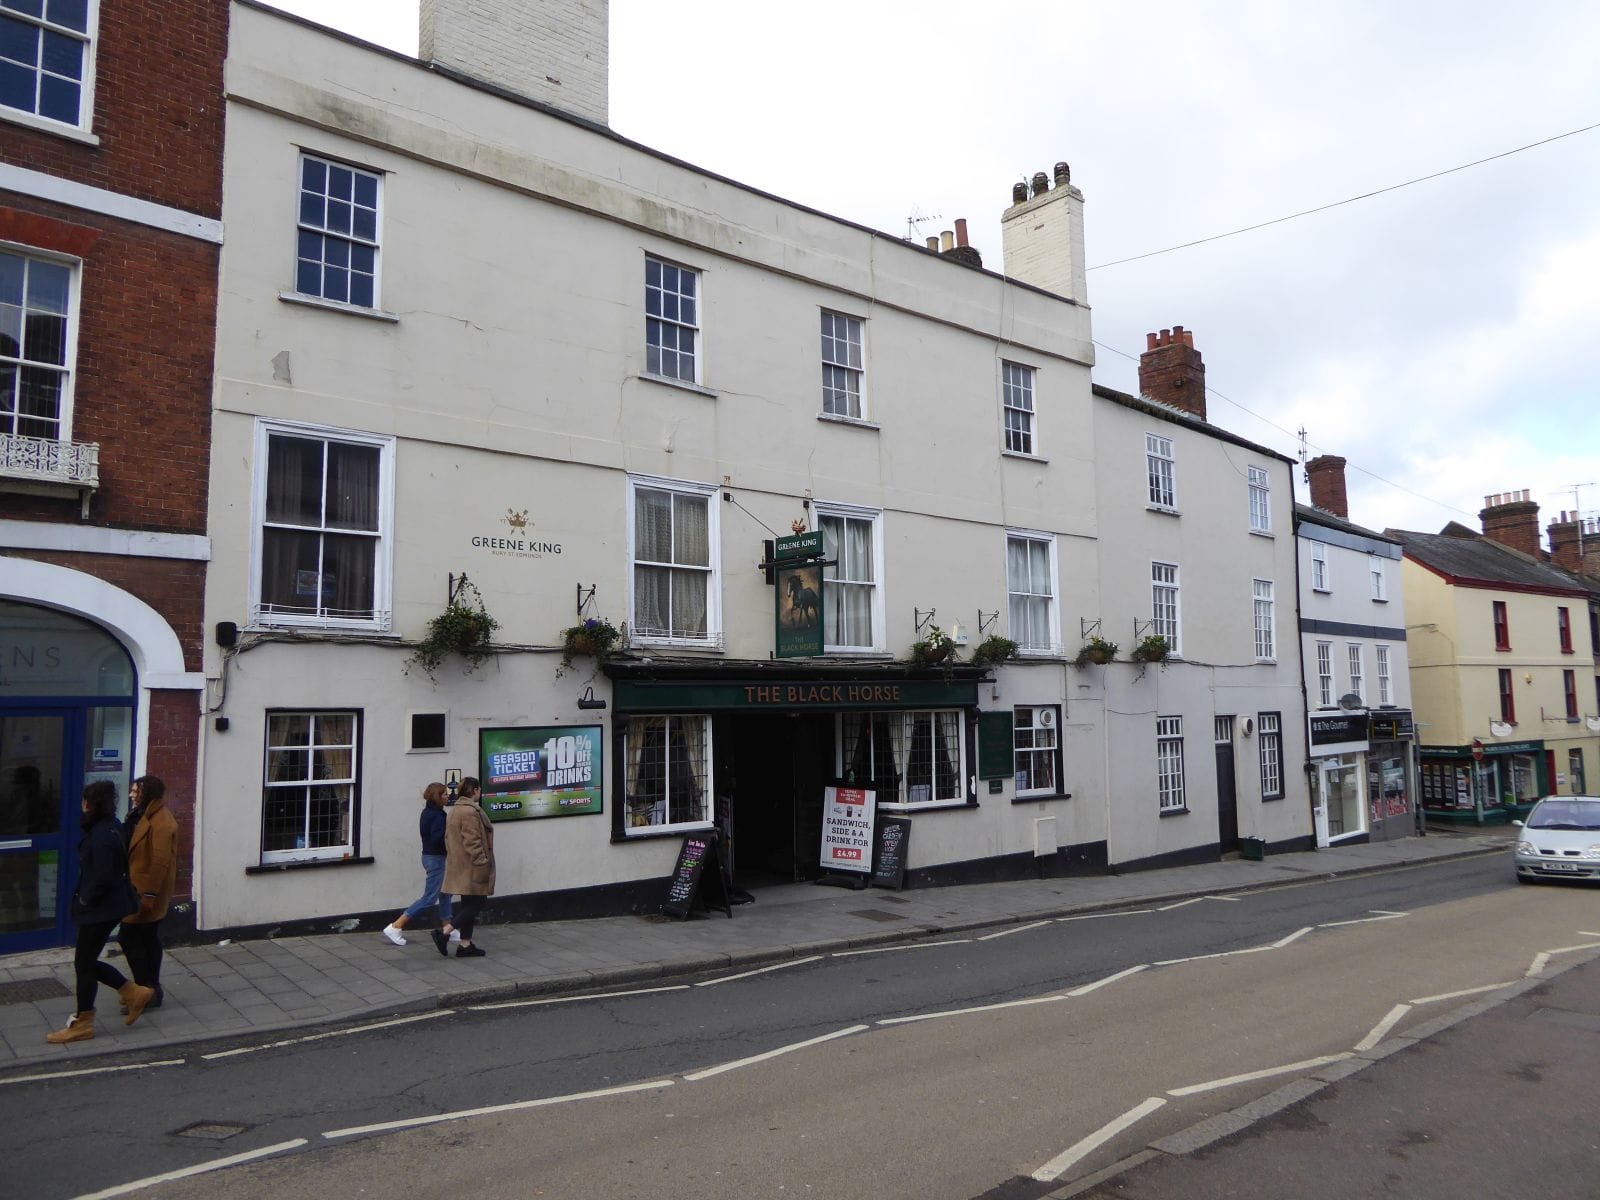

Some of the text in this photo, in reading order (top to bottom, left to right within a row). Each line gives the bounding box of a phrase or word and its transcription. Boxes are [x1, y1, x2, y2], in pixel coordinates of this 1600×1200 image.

[471, 536, 562, 554] GREENE KING
[777, 538, 817, 551] GREENE KING
[0, 646, 61, 669] NS
[744, 685, 900, 703] THE BLACK HORSE
[493, 751, 536, 765] SEASON
[544, 735, 592, 771] 10%
[576, 750, 592, 763] OFF
[494, 761, 536, 775] TICKET
[547, 766, 592, 787] DRINKS
[503, 802, 519, 810] Sport
[569, 797, 591, 805] SPORTS
[826, 817, 871, 830] SANDWICH,
[831, 828, 850, 836] SIDE
[858, 830, 864, 838] A
[826, 835, 869, 847] DRINK FOR
[836, 849, 857, 858] £4.99
